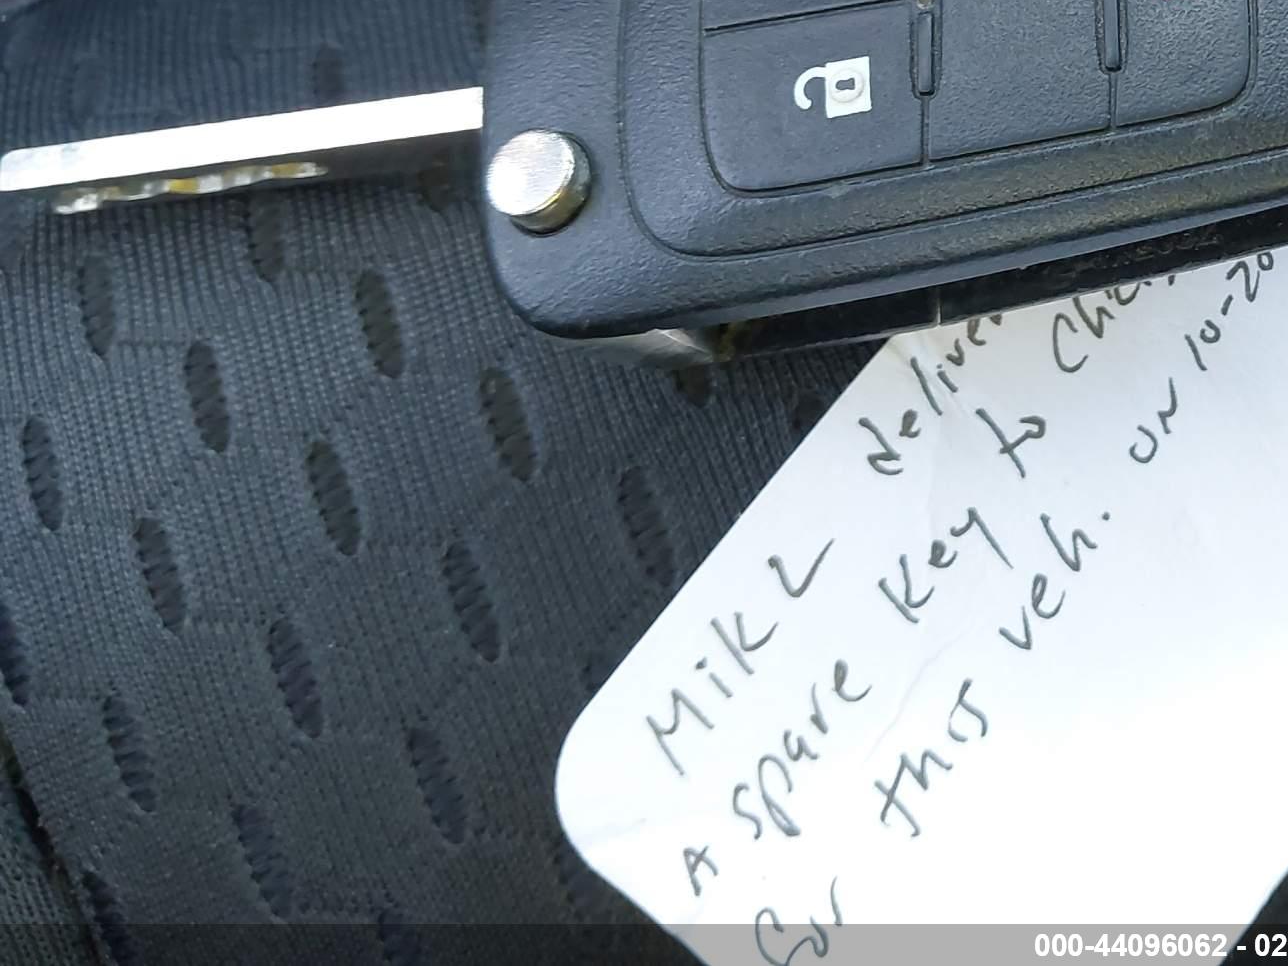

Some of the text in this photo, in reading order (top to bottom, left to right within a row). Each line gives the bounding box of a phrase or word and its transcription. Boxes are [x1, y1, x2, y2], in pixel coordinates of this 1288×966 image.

[732, 658, 872, 840] spare
[976, 407, 1047, 479] to
[873, 678, 988, 838] this
[998, 511, 1111, 651] veh.
